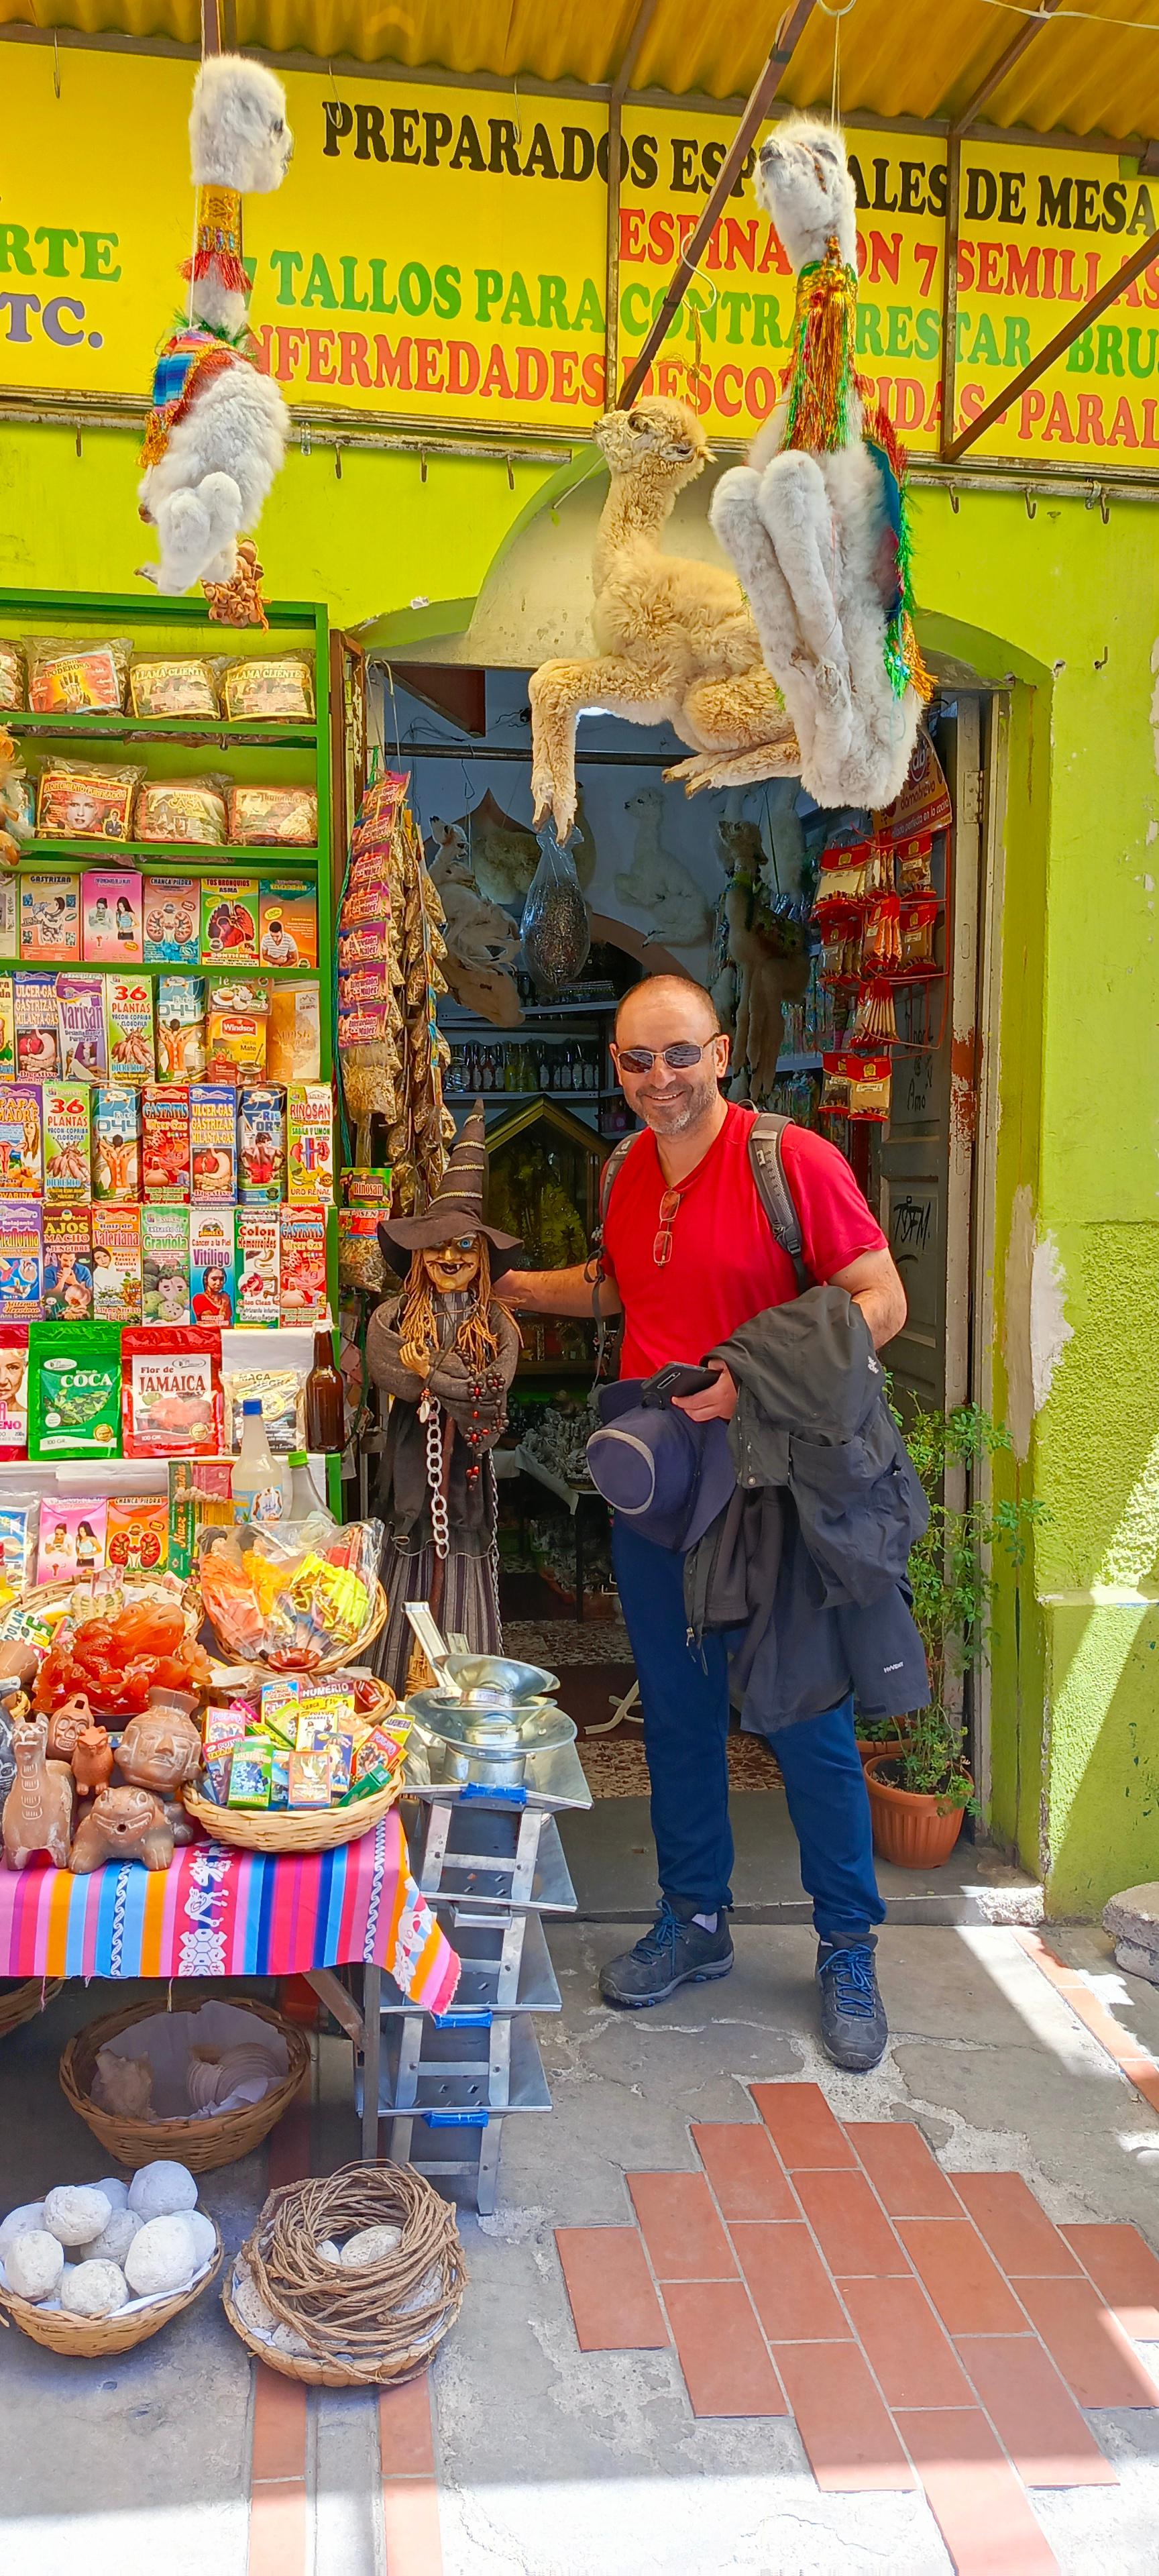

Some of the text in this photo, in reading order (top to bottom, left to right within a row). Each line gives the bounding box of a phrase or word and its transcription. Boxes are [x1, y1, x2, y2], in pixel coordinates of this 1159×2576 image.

[322, 101, 658, 189] PREPARADOS
[964, 168, 1026, 225] DE
[1036, 175, 1158, 237] MESA
[914, 242, 938, 297] 7
[270, 249, 461, 320] TALLOS
[474, 269, 606, 333] PARA
[46, 661, 90, 678] PODEROSA
[262, 668, 306, 679] CLIENTES
[169, 798, 204, 810] CASA
[16, 985, 57, 998] ULCER-GAS
[114, 985, 148, 1001] 36
[15, 999, 58, 1012] GASTRIZAN
[111, 1002, 151, 1014] PLANTAS
[15, 1013, 58, 1025] MILANTA-GAS
[60, 1002, 104, 1030] Varisan
[223, 1022, 255, 1032] Windsor
[18, 1070, 58, 1079] Digestivo
[50, 1098, 85, 1114] 36
[144, 1102, 188, 1119] GASTRITIS
[192, 1104, 233, 1117] ULCER-GAS
[290, 1102, 331, 1120] RIÑOSAN
[48, 1116, 89, 1127] PLANTAS
[191, 1118, 234, 1130] GASTRIZAN
[292, 1127, 309, 1135] SABILA
[192, 1132, 235, 1144] MILANTA-GAS
[308, 1188, 331, 1196] RENAL
[354, 1180, 382, 1195] Riñosan
[44, 1222, 89, 1234] AJOS
[239, 1226, 276, 1237] Colon
[281, 1224, 323, 1239] GASTRITIS
[44, 1234, 89, 1243] MACHO
[94, 1232, 139, 1246] Valeriana
[144, 1236, 187, 1250] Graviola
[193, 1248, 230, 1267] Vitíligo
[60, 1373, 113, 1388] COCA
[138, 1375, 207, 1396] JAMAICA
